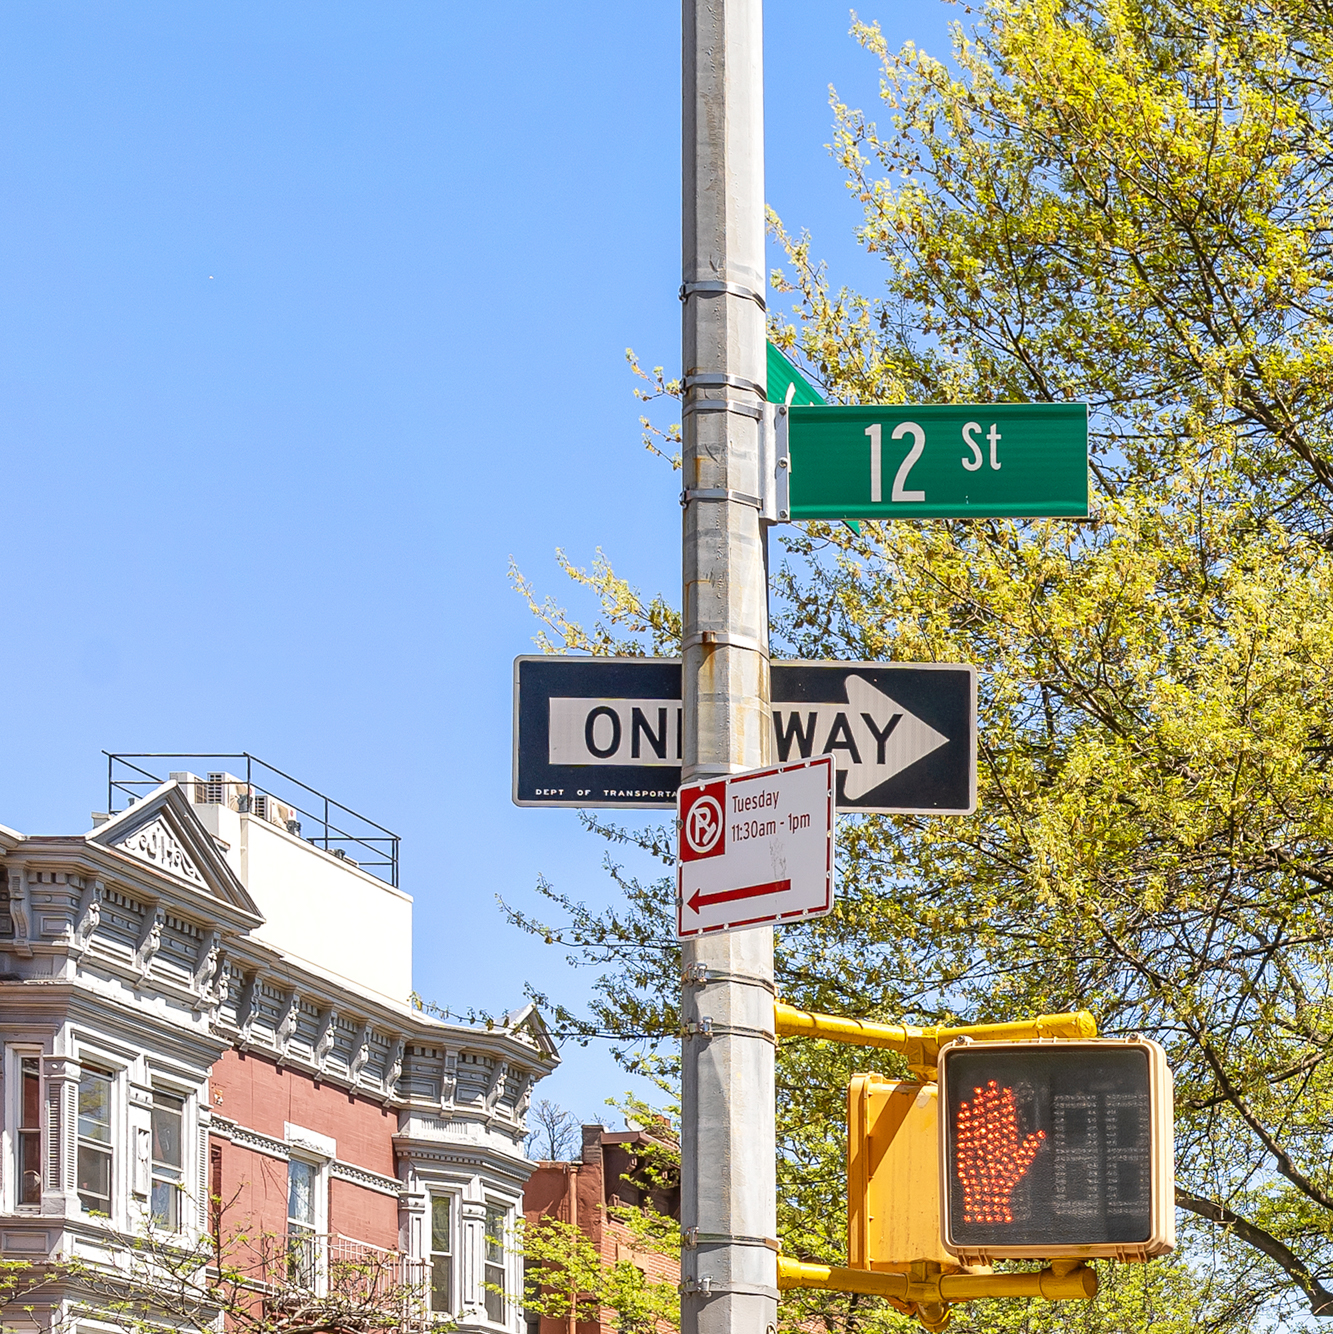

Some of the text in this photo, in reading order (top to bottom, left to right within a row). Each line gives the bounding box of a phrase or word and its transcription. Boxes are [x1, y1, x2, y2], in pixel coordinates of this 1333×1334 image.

[865, 422, 1001, 502] 12 St
[585, 706, 903, 765] ON WAY
[535, 788, 591, 797] DEPT OF
[731, 790, 780, 813] Tuesday
[731, 811, 811, 842] 11:30am 1pm
